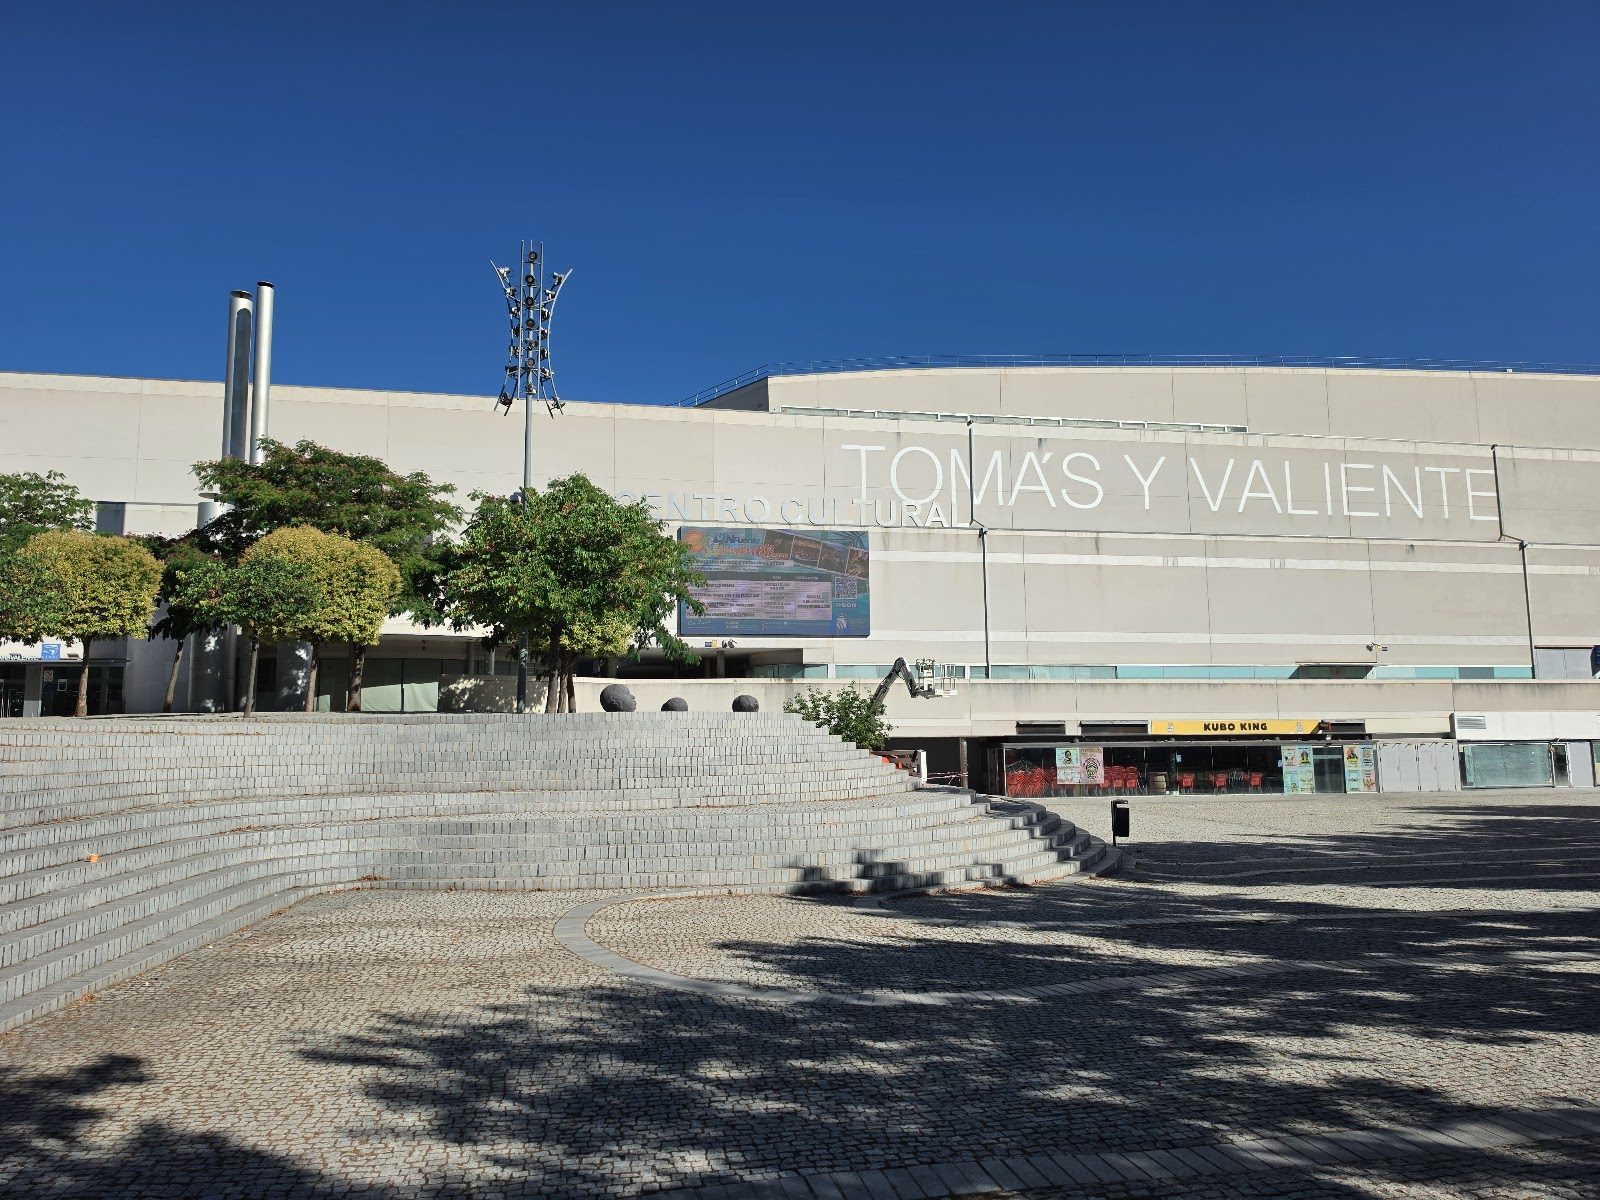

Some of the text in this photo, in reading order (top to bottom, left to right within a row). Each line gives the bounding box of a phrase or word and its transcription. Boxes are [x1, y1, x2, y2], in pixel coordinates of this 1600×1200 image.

[840, 443, 1501, 521] TOMÁS Y VALIENTE
[780, 497, 971, 528] CULTURAL
[1203, 722, 1268, 732] KUBO KING
